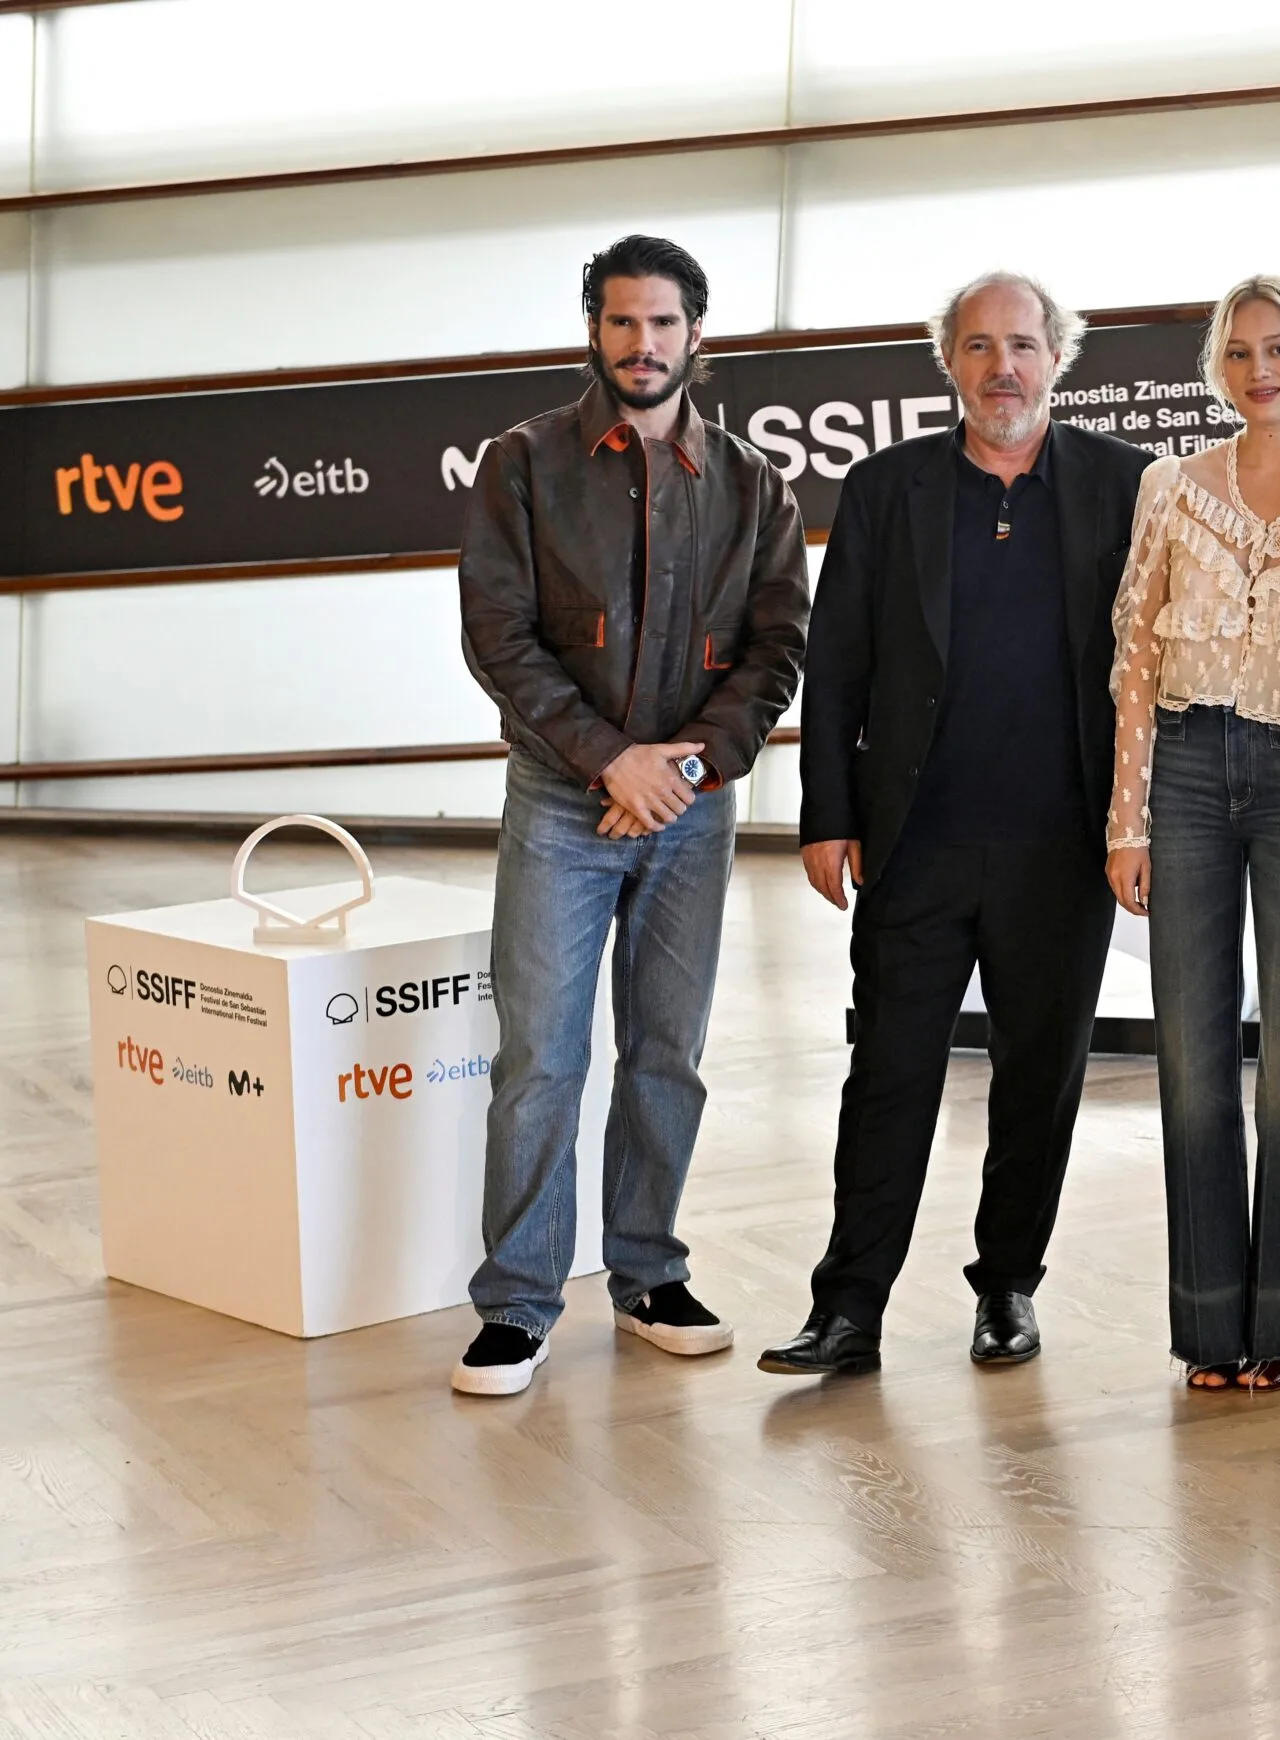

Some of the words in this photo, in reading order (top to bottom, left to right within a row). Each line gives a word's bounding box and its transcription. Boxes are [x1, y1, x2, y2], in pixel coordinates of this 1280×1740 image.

[1049, 383, 1129, 408] onostia
[1134, 380, 1215, 401] Zinema
[1060, 412, 1117, 432] tival
[1122, 410, 1151, 431] de
[1156, 407, 1200, 428] San
[748, 395, 965, 482] SSIF
[56, 453, 184, 522] rtve
[293, 458, 370, 498] eitb
[137, 970, 196, 1009] SSIFF
[200, 982, 223, 995] Donostia
[201, 994, 221, 1005] Festival
[222, 999, 228, 1007] de
[229, 1000, 239, 1010] San
[376, 974, 470, 1017] SSIFF
[201, 1005, 233, 1019] International
[235, 1012, 246, 1022] Film
[247, 1015, 267, 1027] Festival
[118, 1036, 164, 1085] rtve
[448, 1054, 491, 1080] eitb
[185, 1064, 214, 1088] eitb
[228, 1070, 264, 1096] M+
[338, 1063, 413, 1102] rtve
